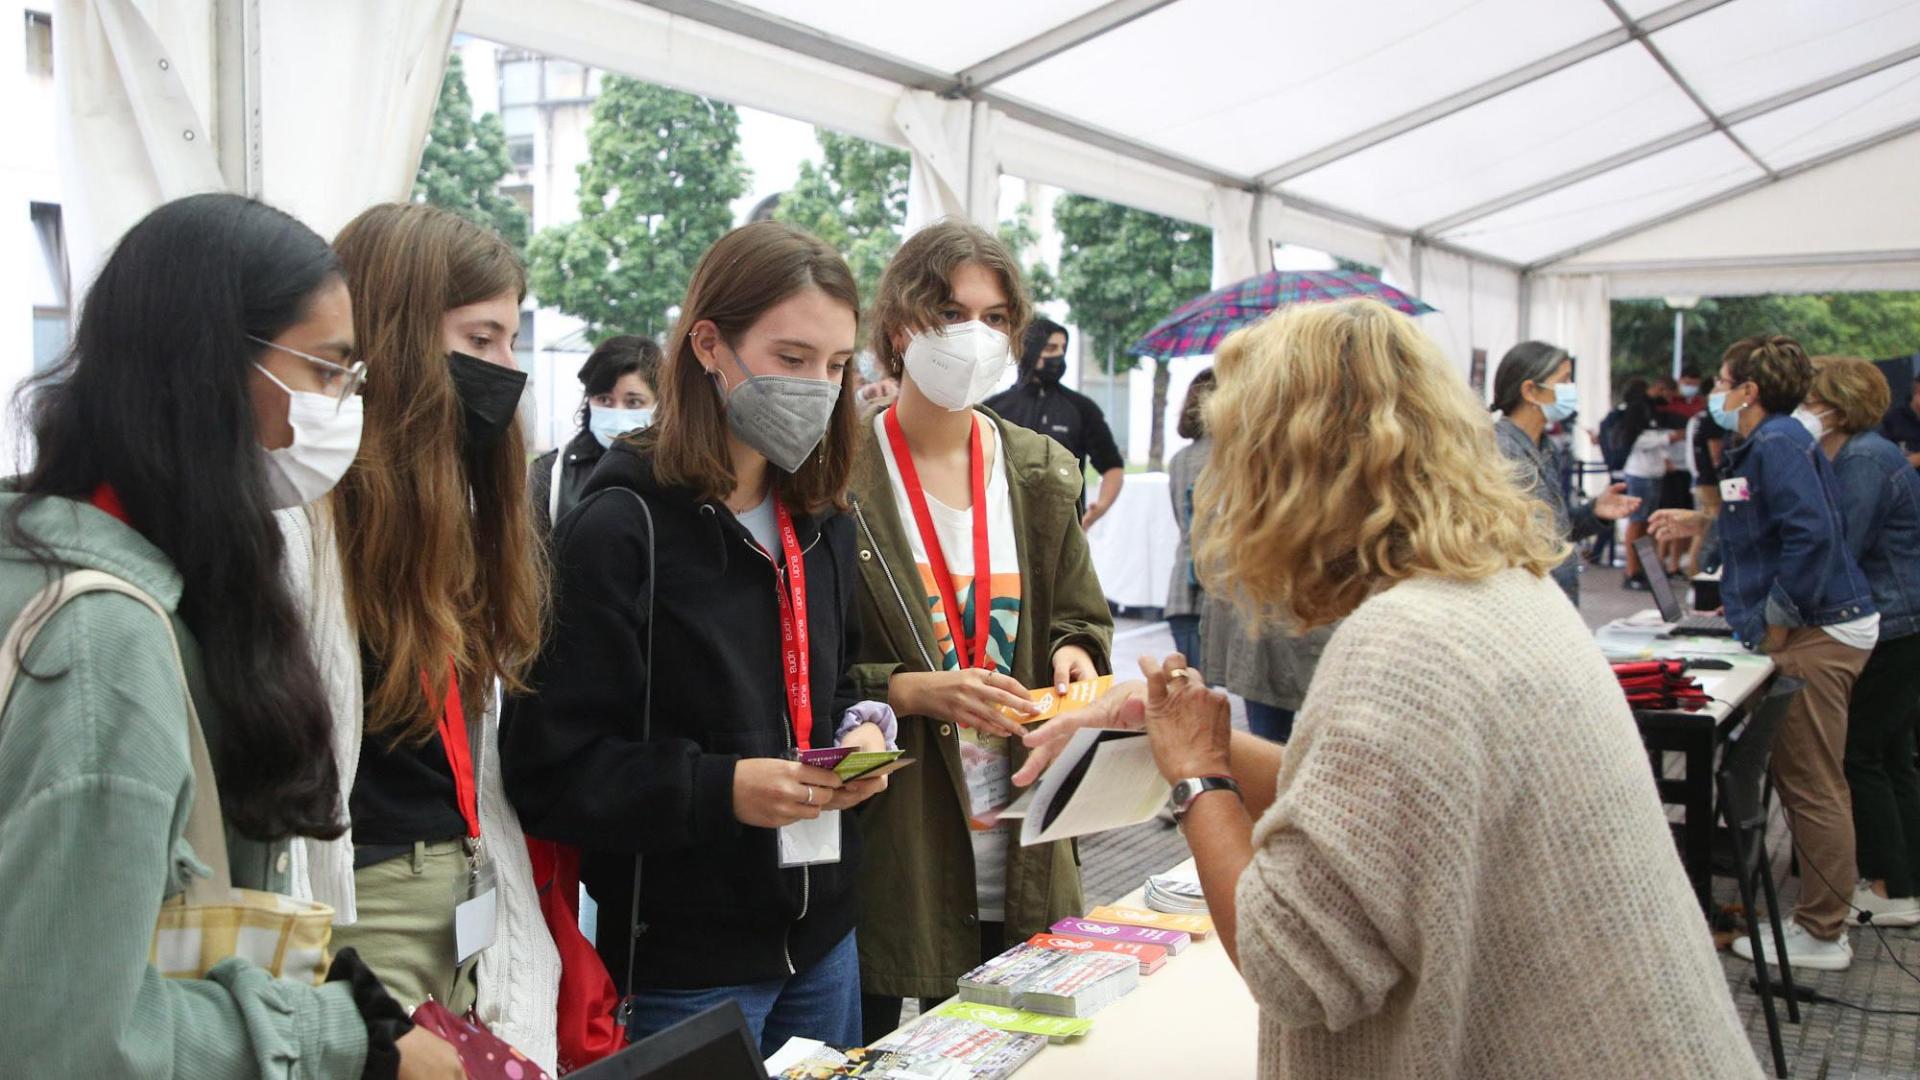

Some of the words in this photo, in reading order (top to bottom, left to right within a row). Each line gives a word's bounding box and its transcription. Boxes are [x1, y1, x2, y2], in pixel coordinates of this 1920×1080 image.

[784, 526, 794, 548] upna
[791, 555, 801, 578] upna
[795, 587, 803, 609] upna
[784, 618, 793, 641] upna
[788, 650, 798, 674] upna
